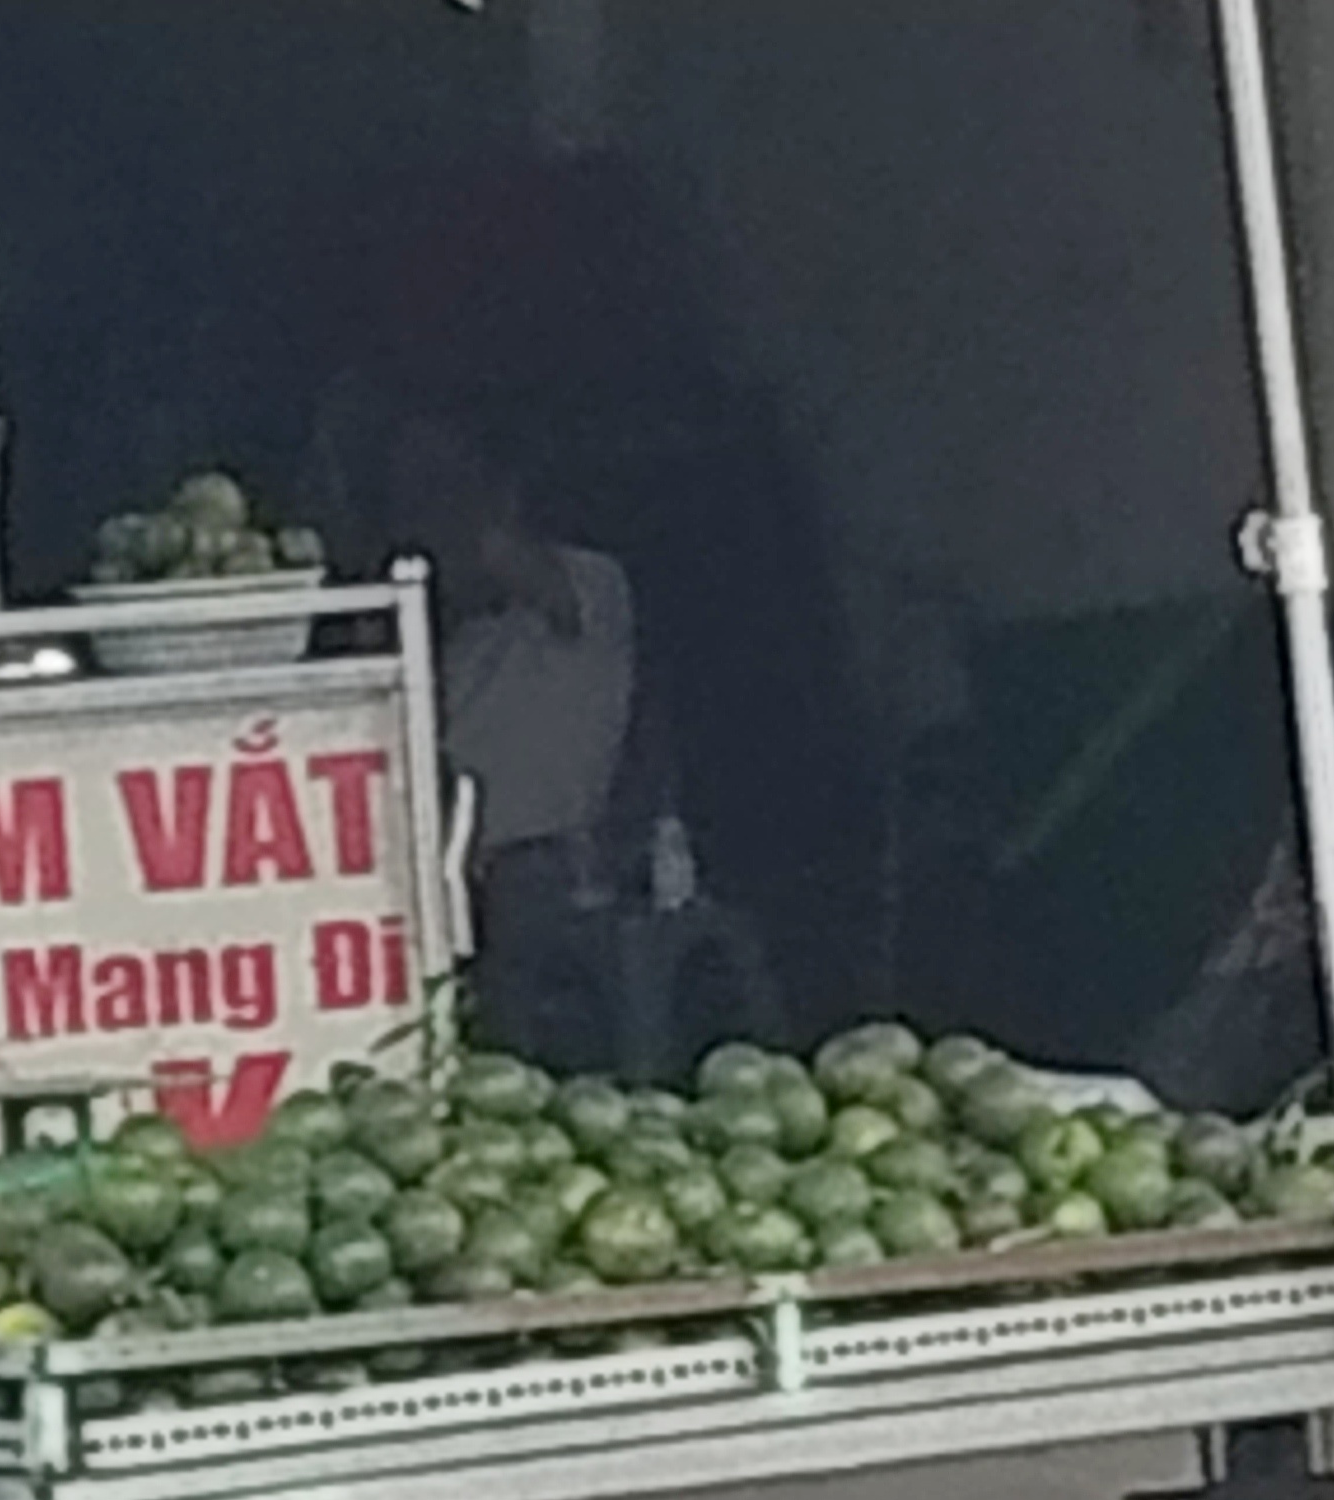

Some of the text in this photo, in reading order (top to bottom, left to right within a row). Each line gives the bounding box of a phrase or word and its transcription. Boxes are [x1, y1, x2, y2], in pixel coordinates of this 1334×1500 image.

[115, 717, 389, 892] VẮT
[1, 942, 278, 1041] Mang
[312, 915, 409, 1012] Đi
